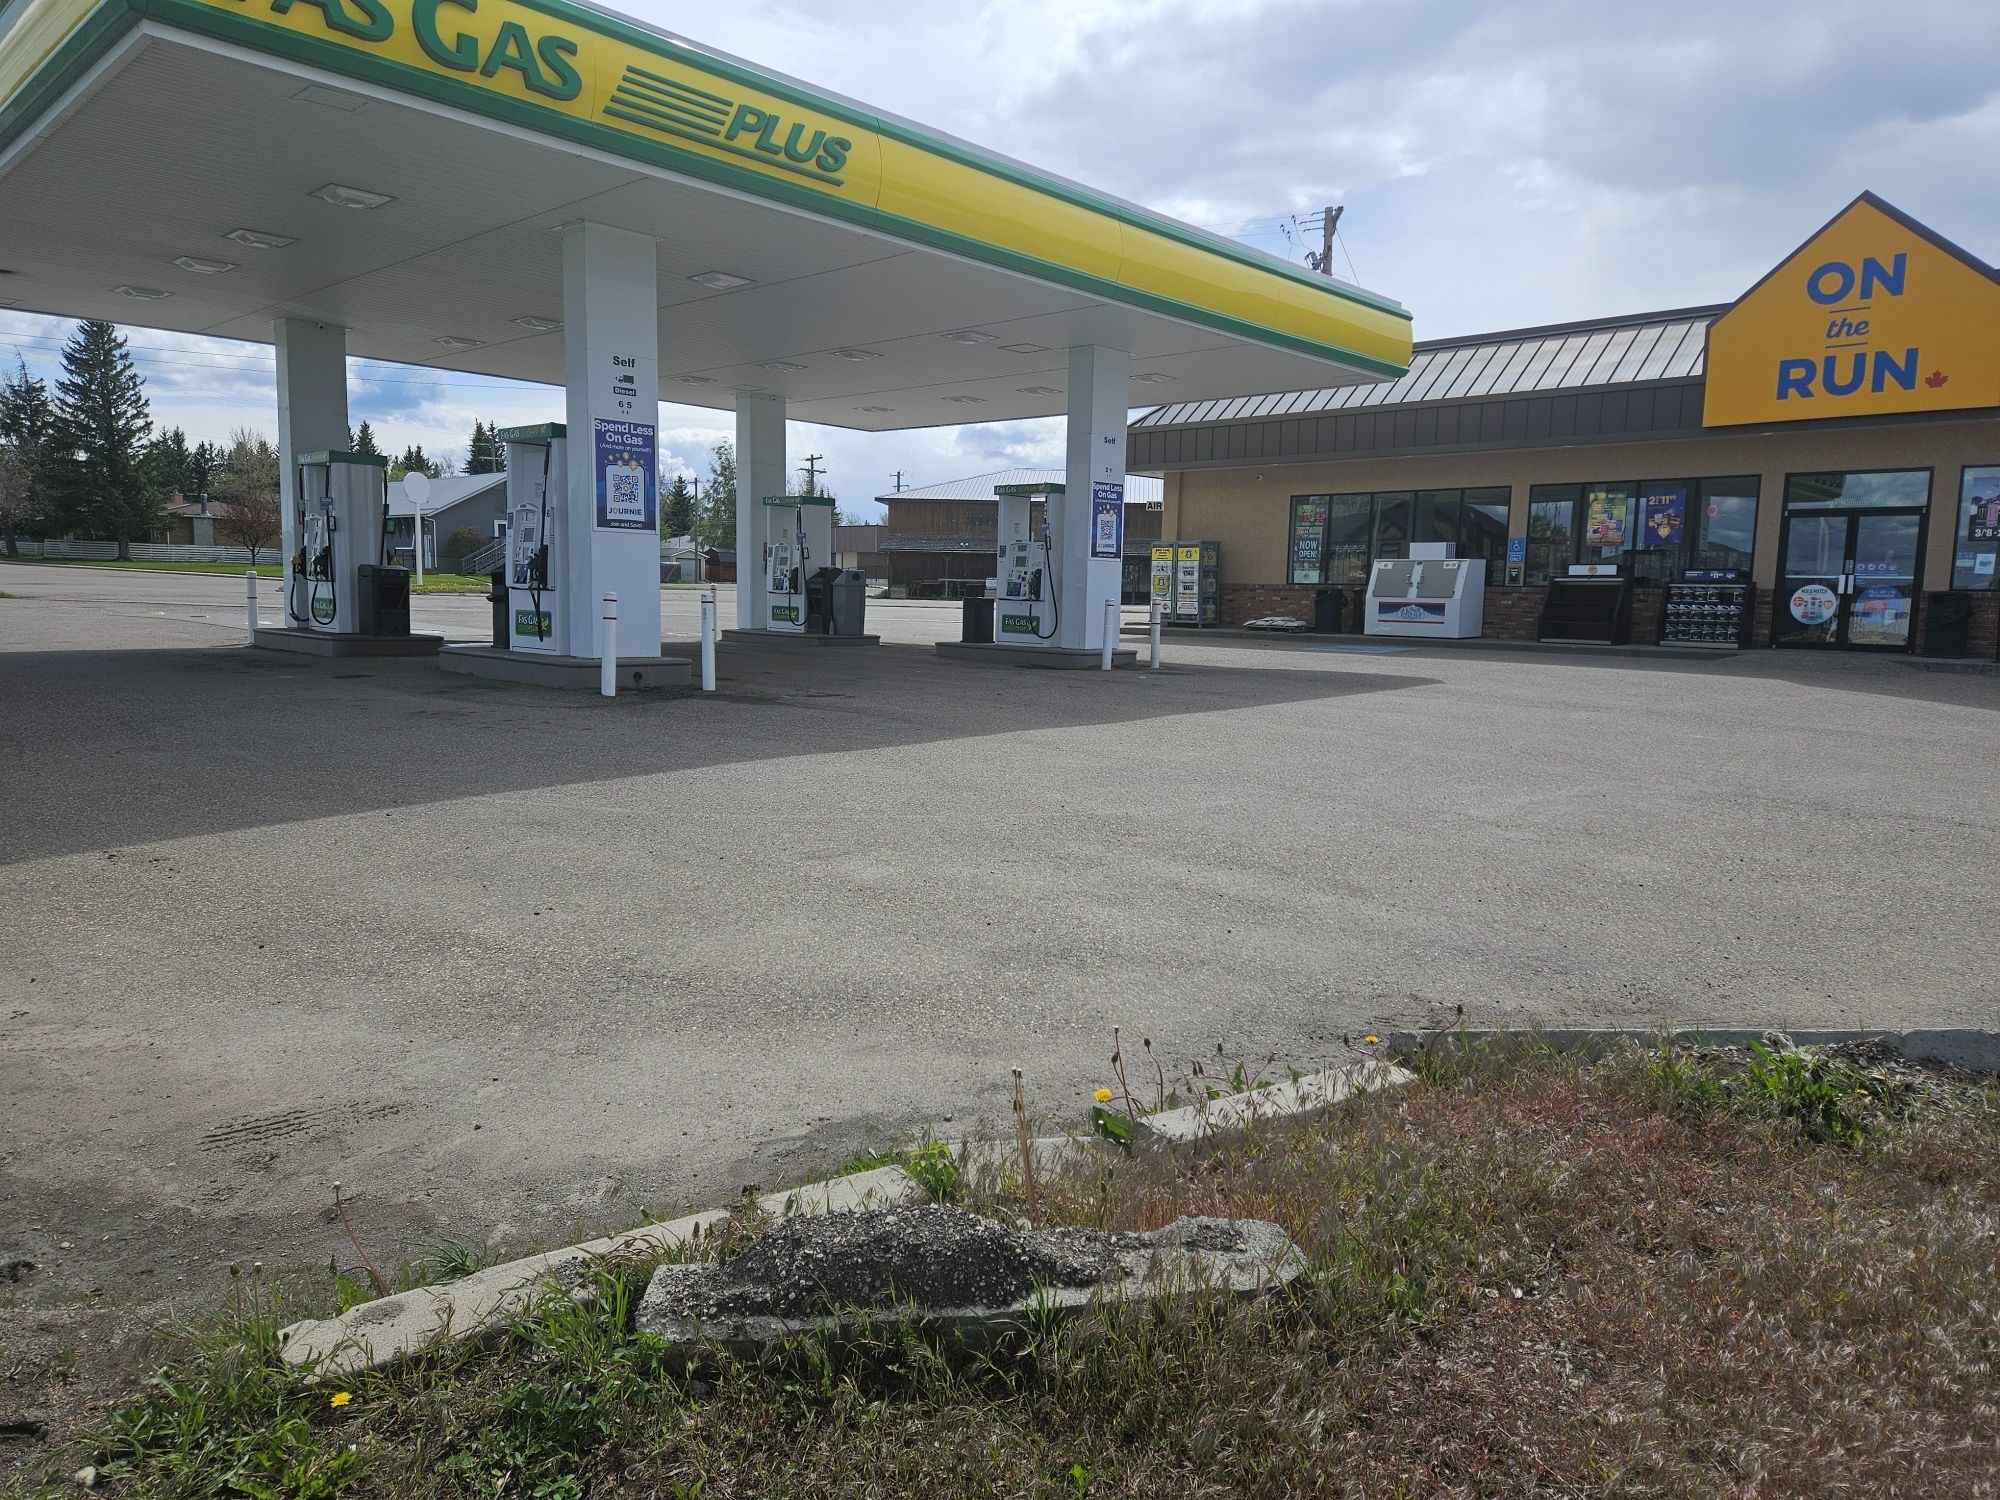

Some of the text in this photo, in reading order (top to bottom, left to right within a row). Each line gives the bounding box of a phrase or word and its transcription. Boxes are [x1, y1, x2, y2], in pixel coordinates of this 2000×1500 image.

[412, 0, 582, 101] GAS
[725, 104, 852, 172] PLUS
[1807, 253, 1907, 305] ON
[1826, 318, 1869, 338] the
[613, 356, 636, 368] Self
[1776, 347, 1919, 400] RUN
[614, 387, 636, 396] Diesel
[594, 420, 654, 436] Spend Less
[605, 432, 643, 445] On Gas
[1103, 436, 1116, 444] Self
[1093, 483, 1123, 492] Spend Less
[608, 507, 643, 515] JOURNIE
[1146, 501, 1162, 510] AIR
[1299, 540, 1318, 550] NOW
[1298, 550, 1318, 558] OPEN!
